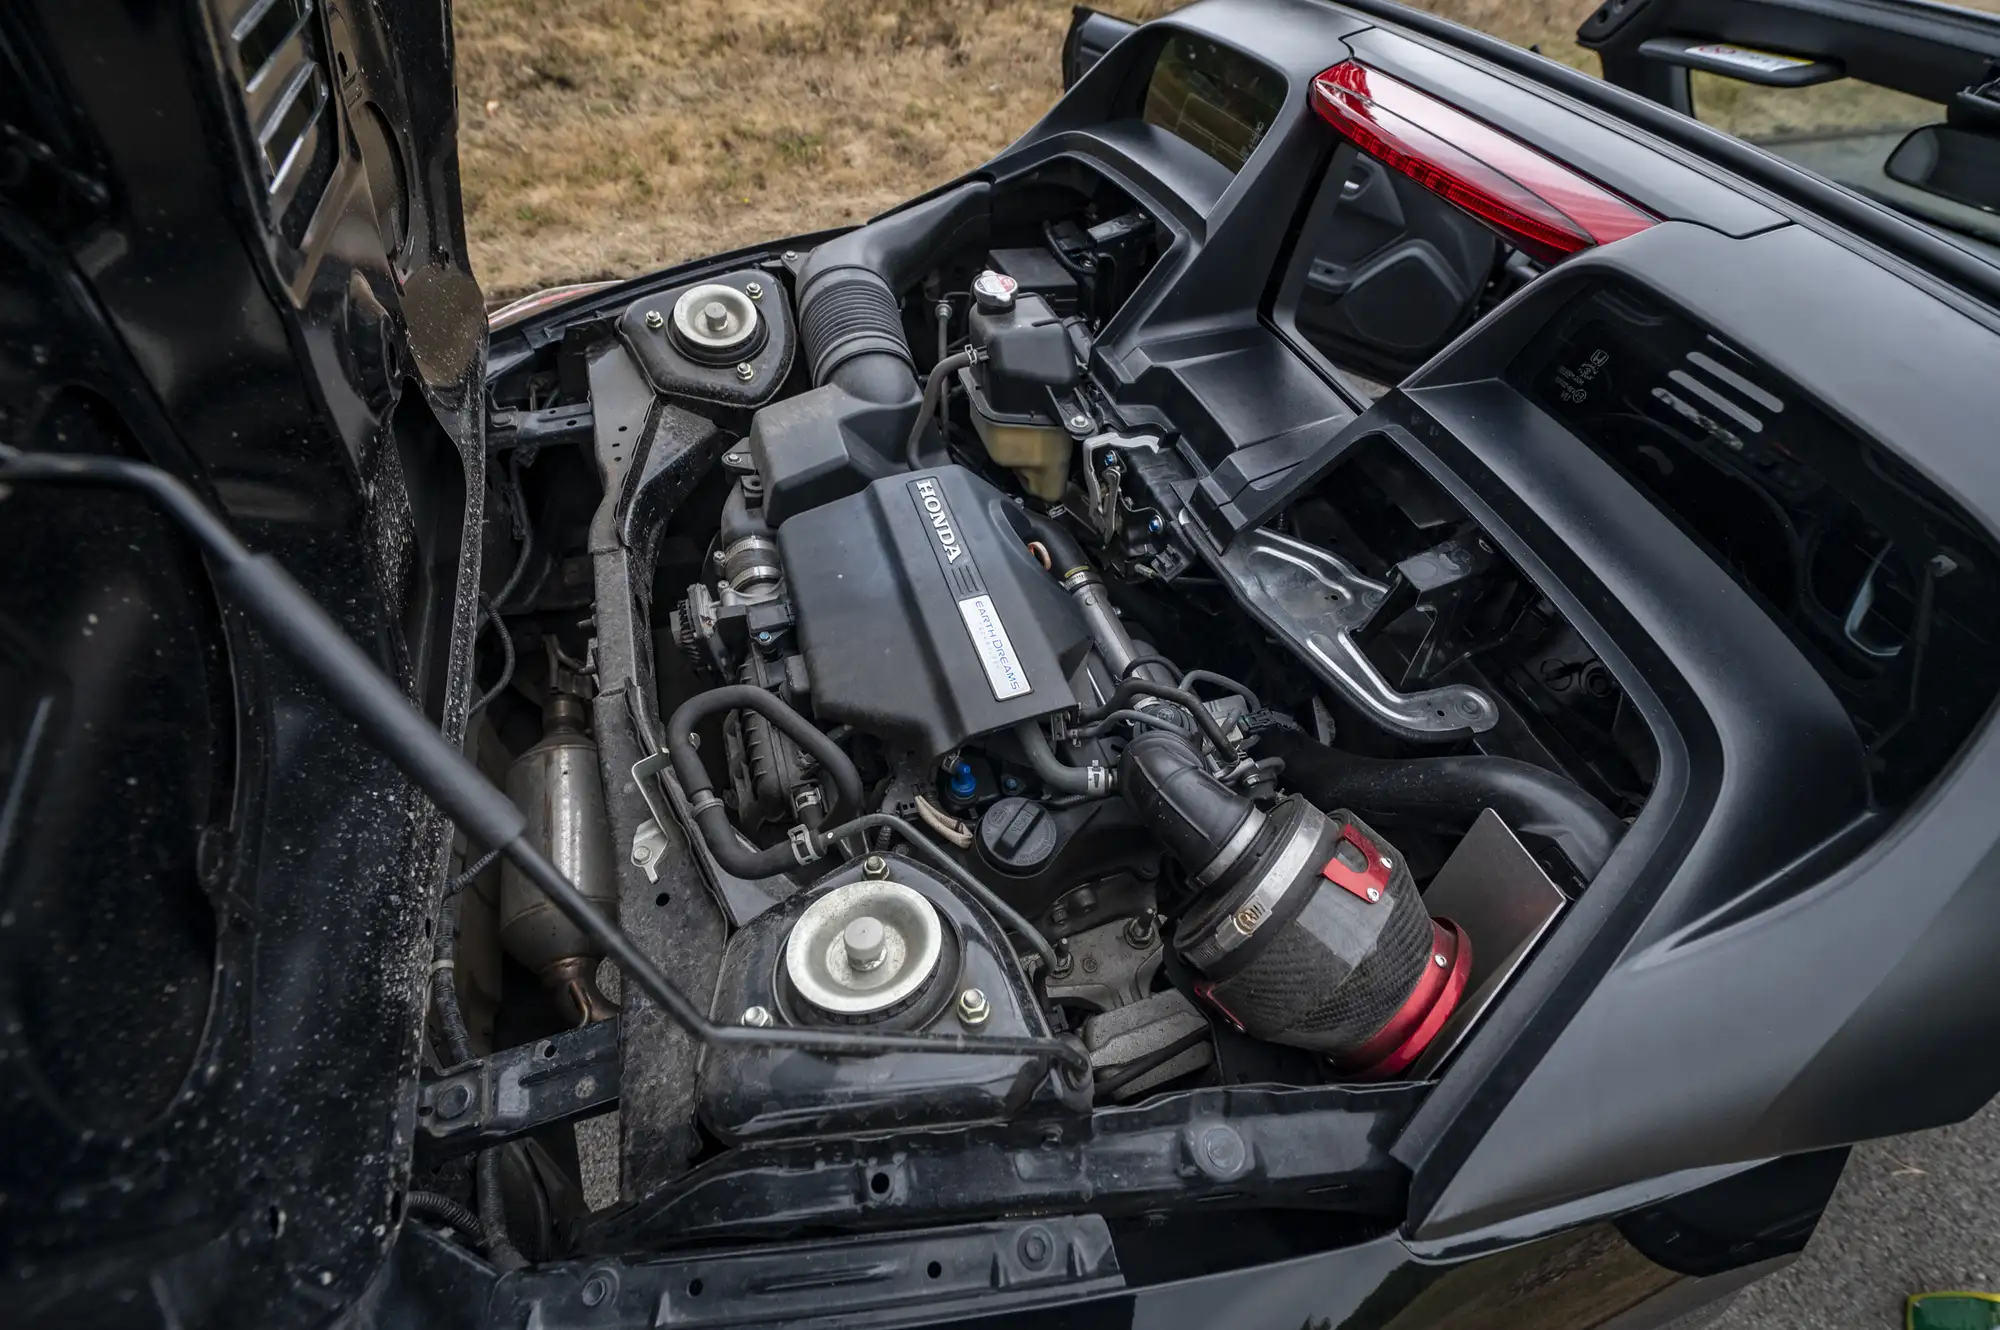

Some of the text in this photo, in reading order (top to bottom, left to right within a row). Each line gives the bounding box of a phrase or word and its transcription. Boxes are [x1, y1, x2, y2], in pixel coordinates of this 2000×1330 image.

[916, 480, 962, 564] HONDA
[975, 600, 996, 638] EARTH
[992, 638, 1020, 690] DREAMS
